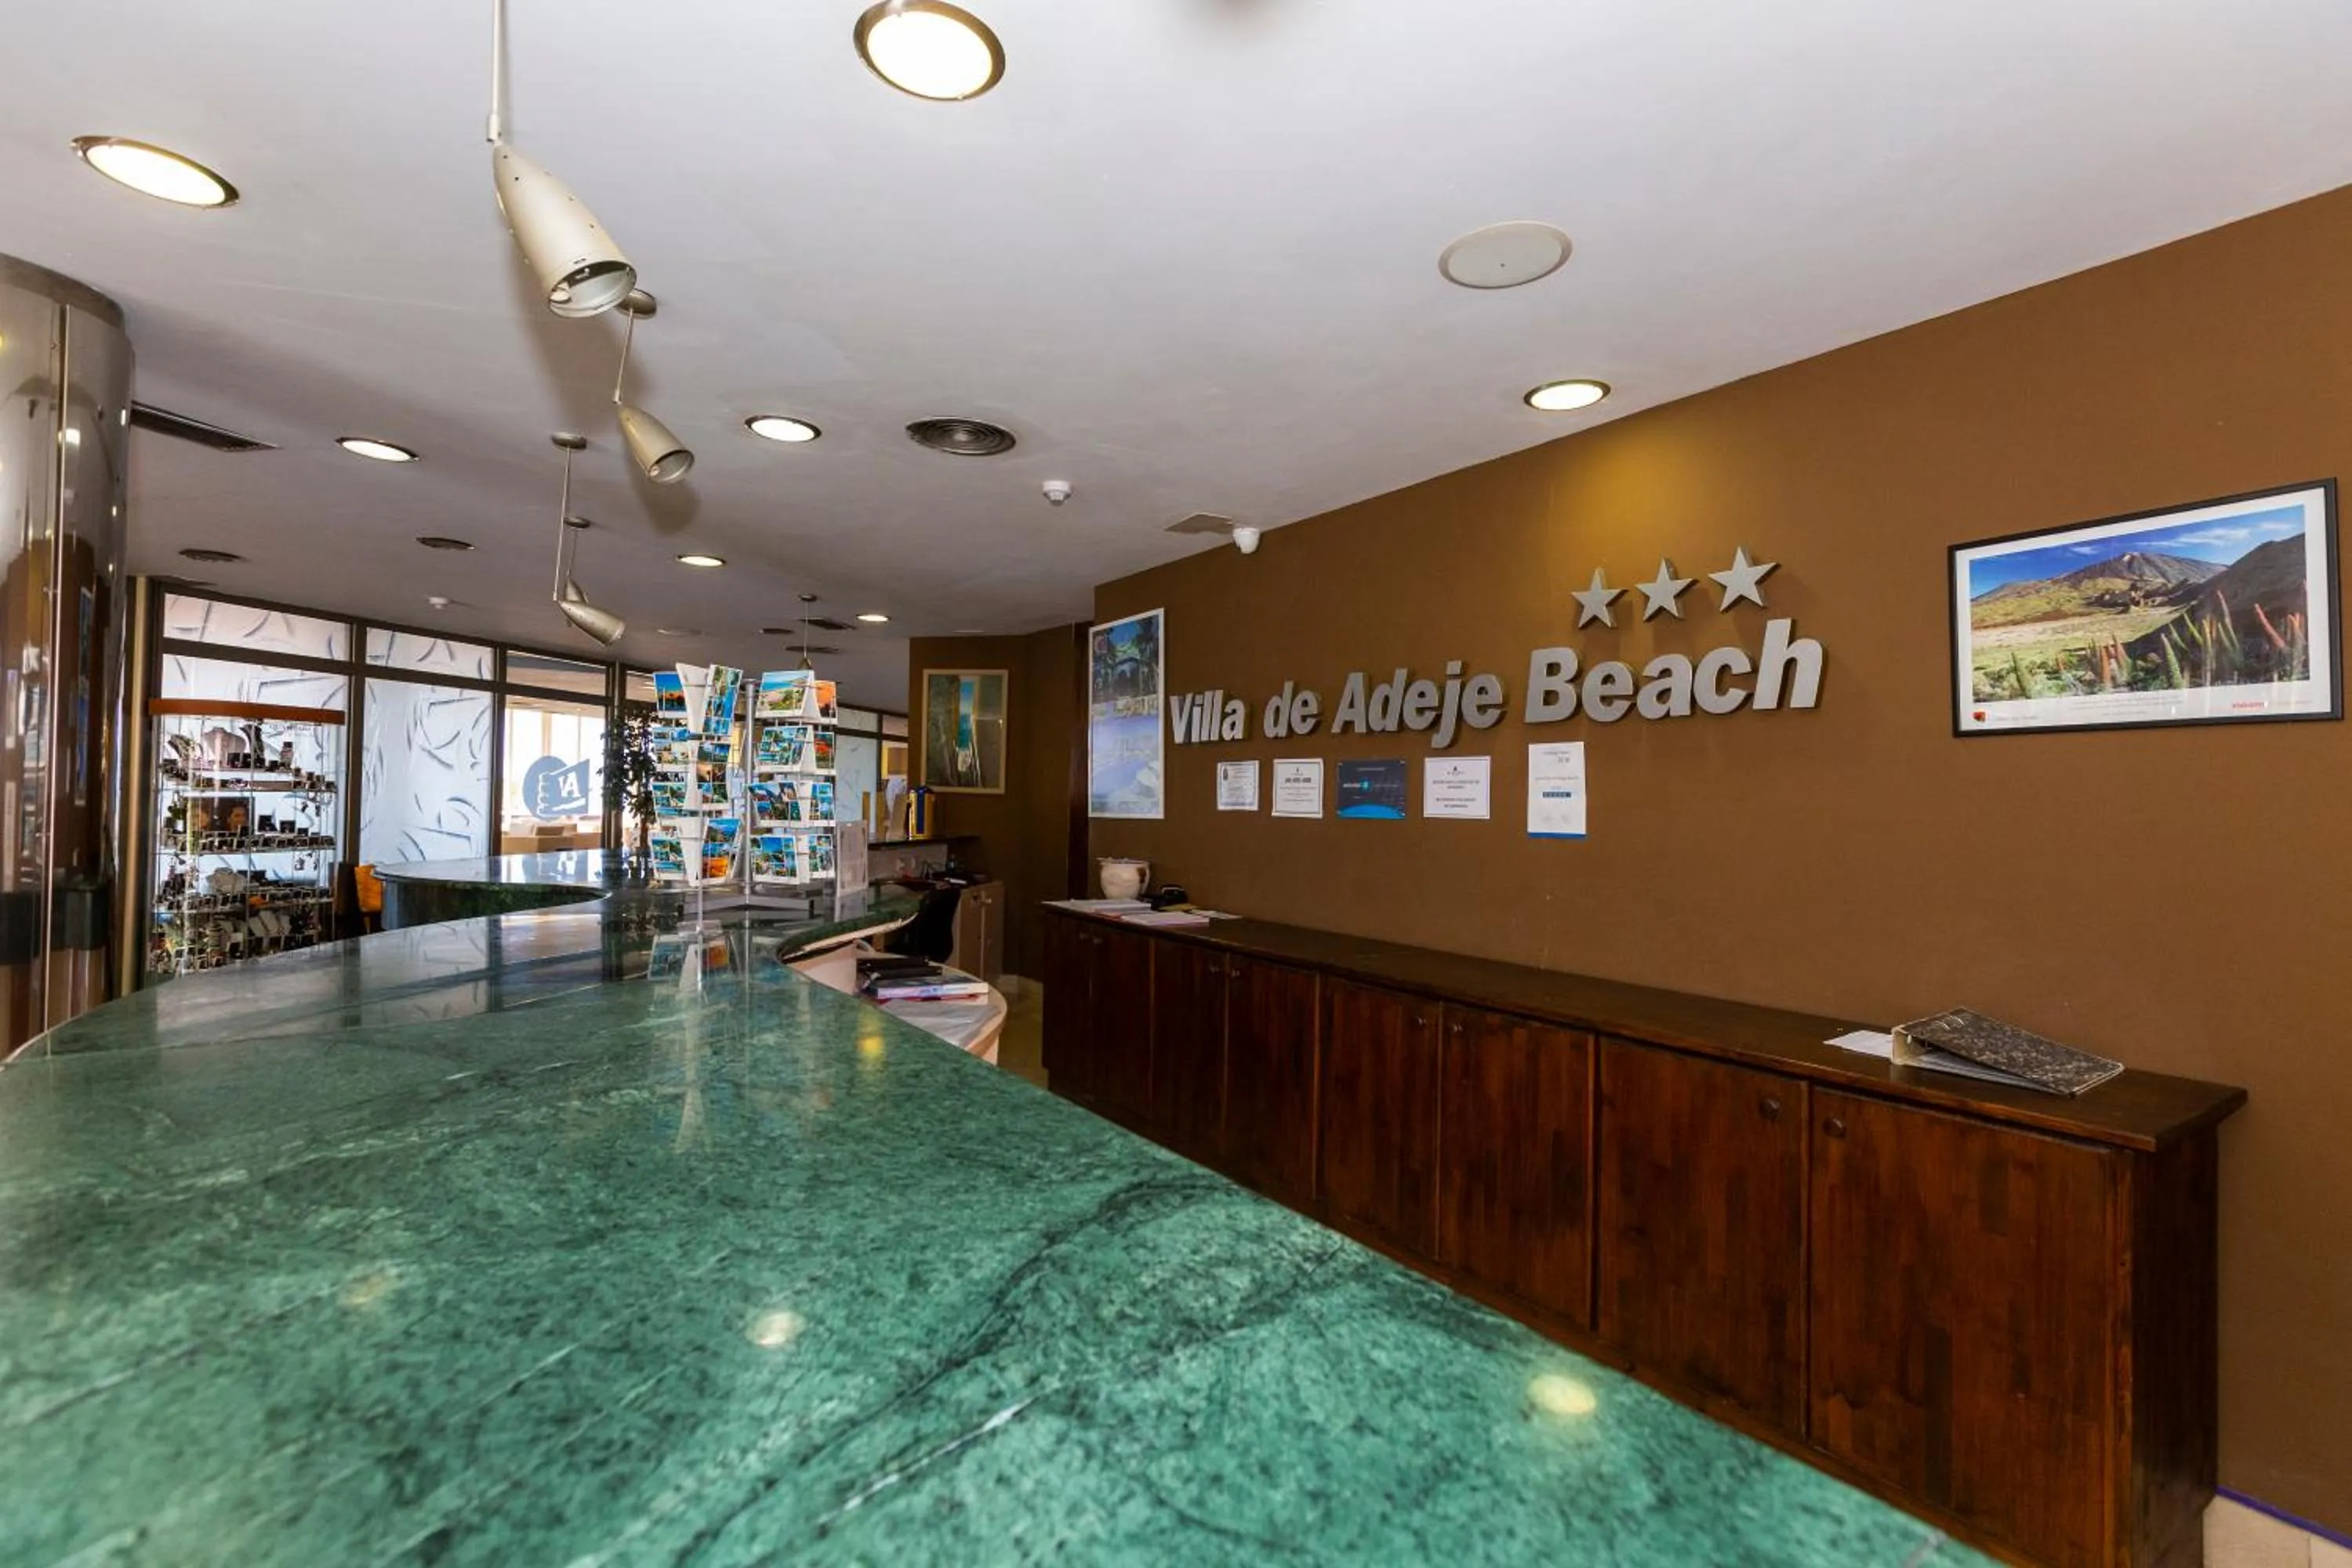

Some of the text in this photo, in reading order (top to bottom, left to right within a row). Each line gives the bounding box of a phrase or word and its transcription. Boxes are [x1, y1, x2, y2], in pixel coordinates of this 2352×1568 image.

[1170, 690, 1247, 743] Villa
[1263, 681, 1318, 737] de
[1332, 660, 1503, 748] Adeje
[1525, 618, 1824, 723] Beach
